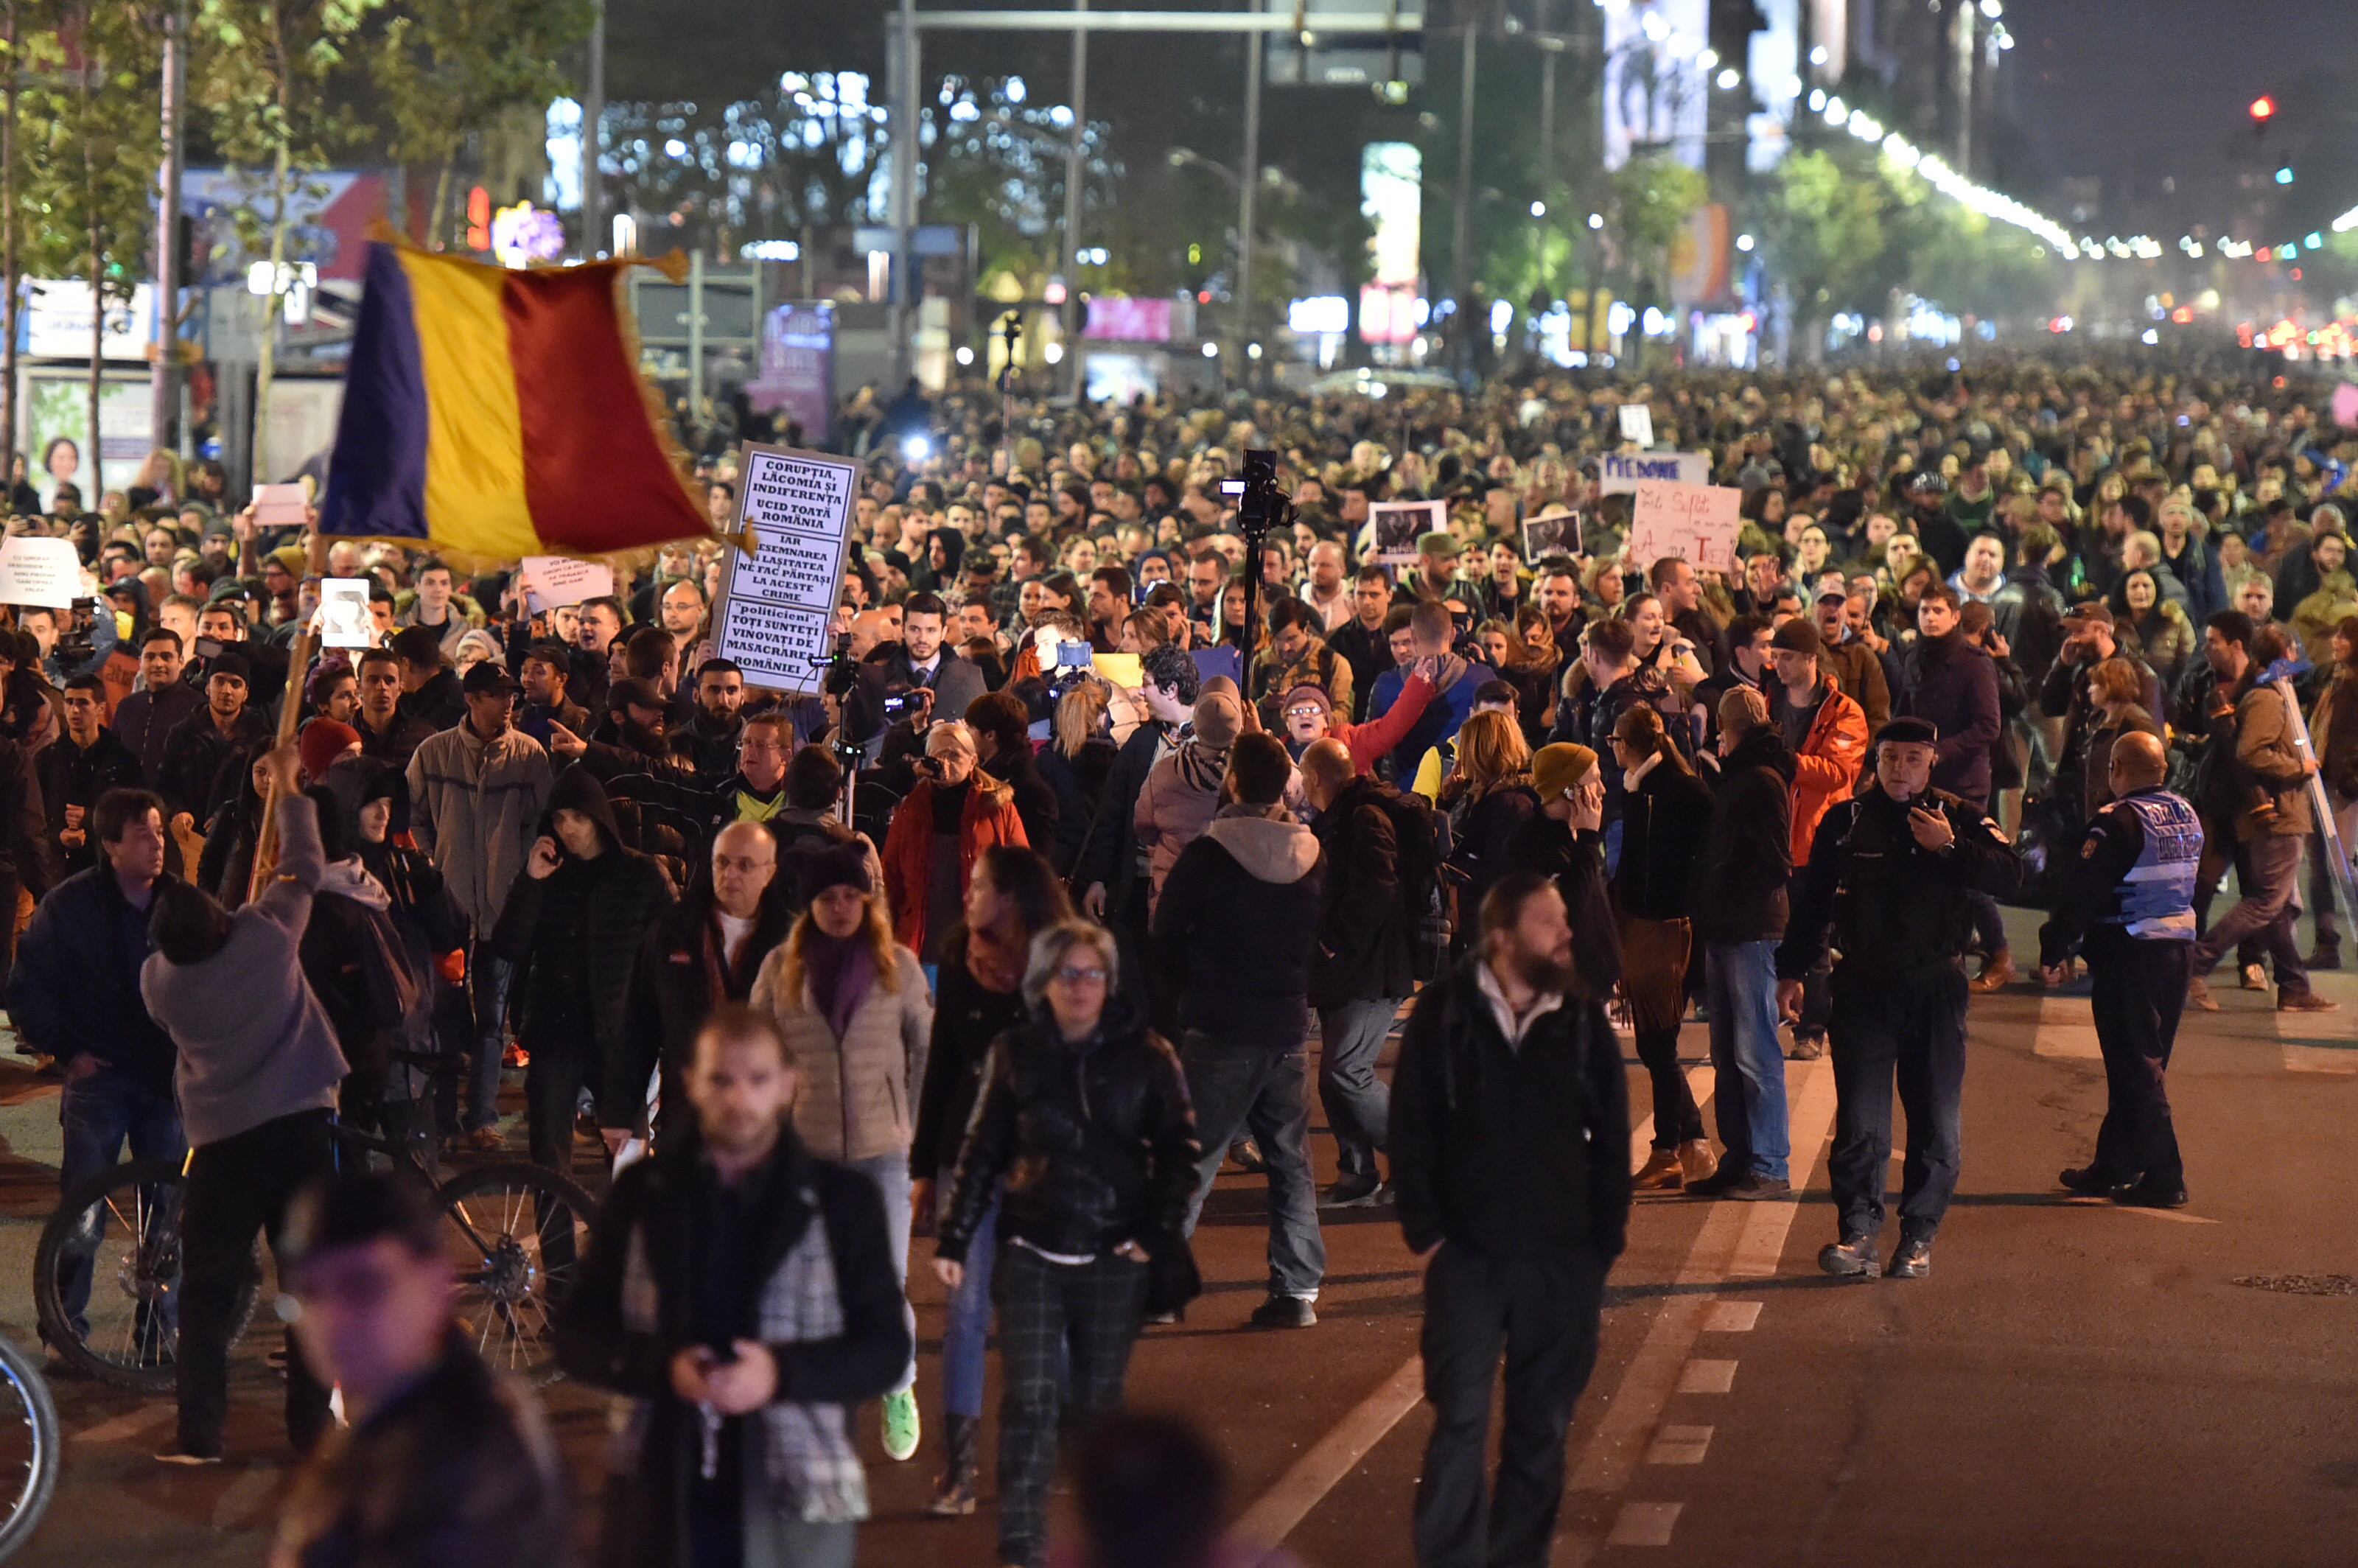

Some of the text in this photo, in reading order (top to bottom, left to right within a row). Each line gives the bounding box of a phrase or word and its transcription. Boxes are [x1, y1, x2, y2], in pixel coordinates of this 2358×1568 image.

[766, 461, 836, 481] CORUPȚIA,
[761, 471, 837, 497] LĂCOMIA ȘI
[752, 483, 842, 506] INDIFERENȚA
[757, 499, 831, 519] UCID TOATĂ
[761, 511, 824, 529] ROMÂNIA
[780, 535, 801, 546] IAR
[755, 543, 828, 561] ESEMNAREA
[762, 555, 824, 572] LAȘITATEA
[738, 562, 830, 586] NE FAC PĂRTAȘI
[752, 576, 814, 592] LA ACESTE
[762, 588, 802, 601] CRIME
[731, 615, 819, 639] TOȚI SUNTEȚI
[732, 628, 814, 648] VINOVAȚI DE
[733, 655, 801, 674] ROMÂNIEI
